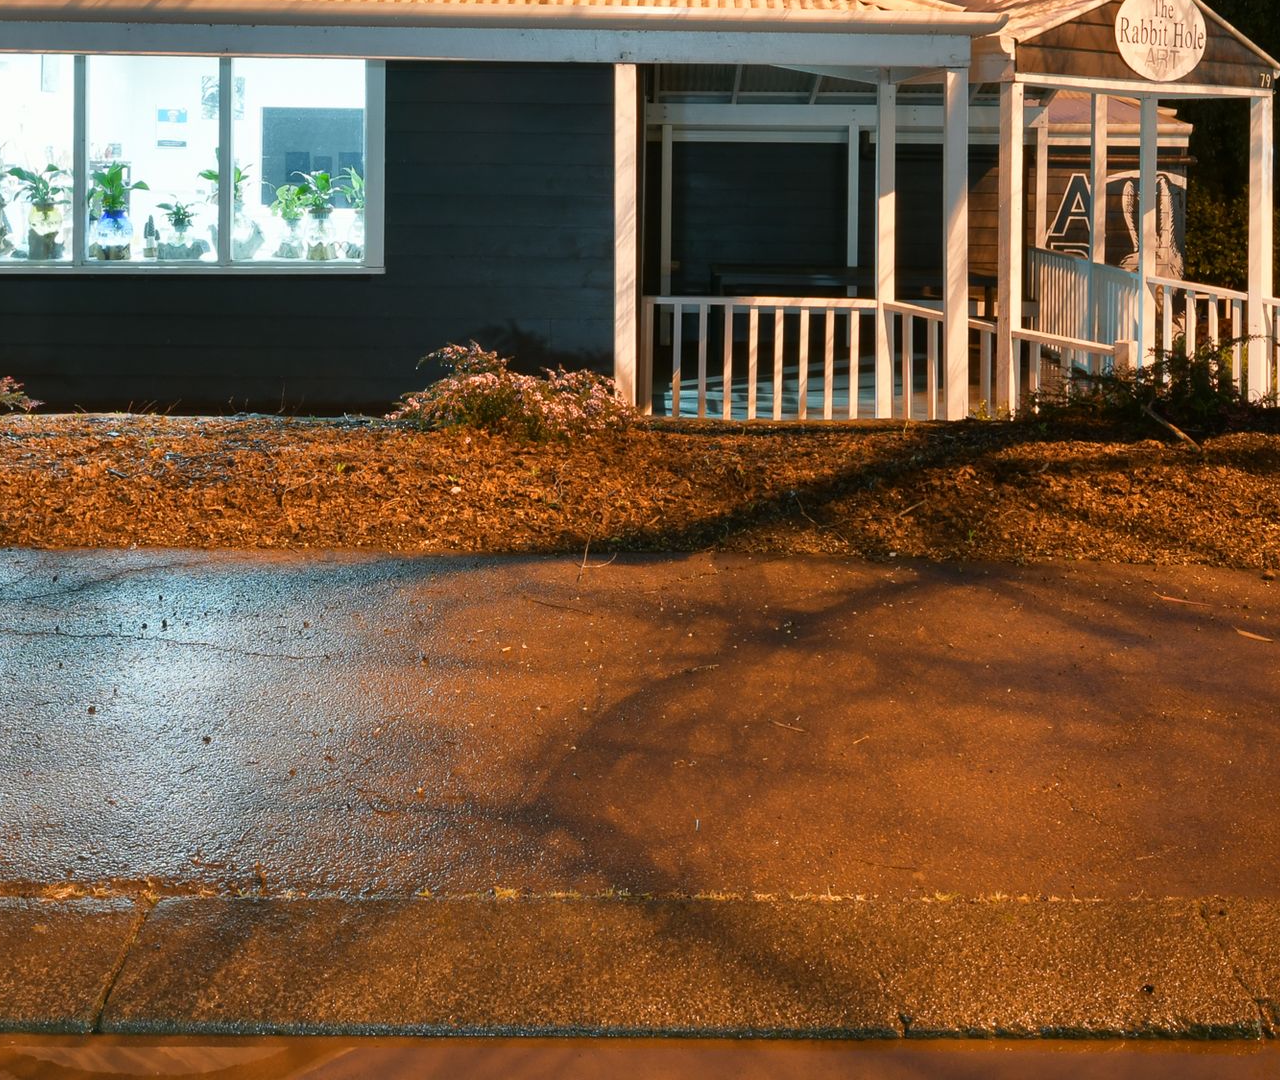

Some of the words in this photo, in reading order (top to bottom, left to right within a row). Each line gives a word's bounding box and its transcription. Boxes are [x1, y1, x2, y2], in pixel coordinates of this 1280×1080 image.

[1120, 17, 1168, 47] Rabbit
[1172, 22, 1205, 50] Hole
[1145, 47, 1180, 70] ART
